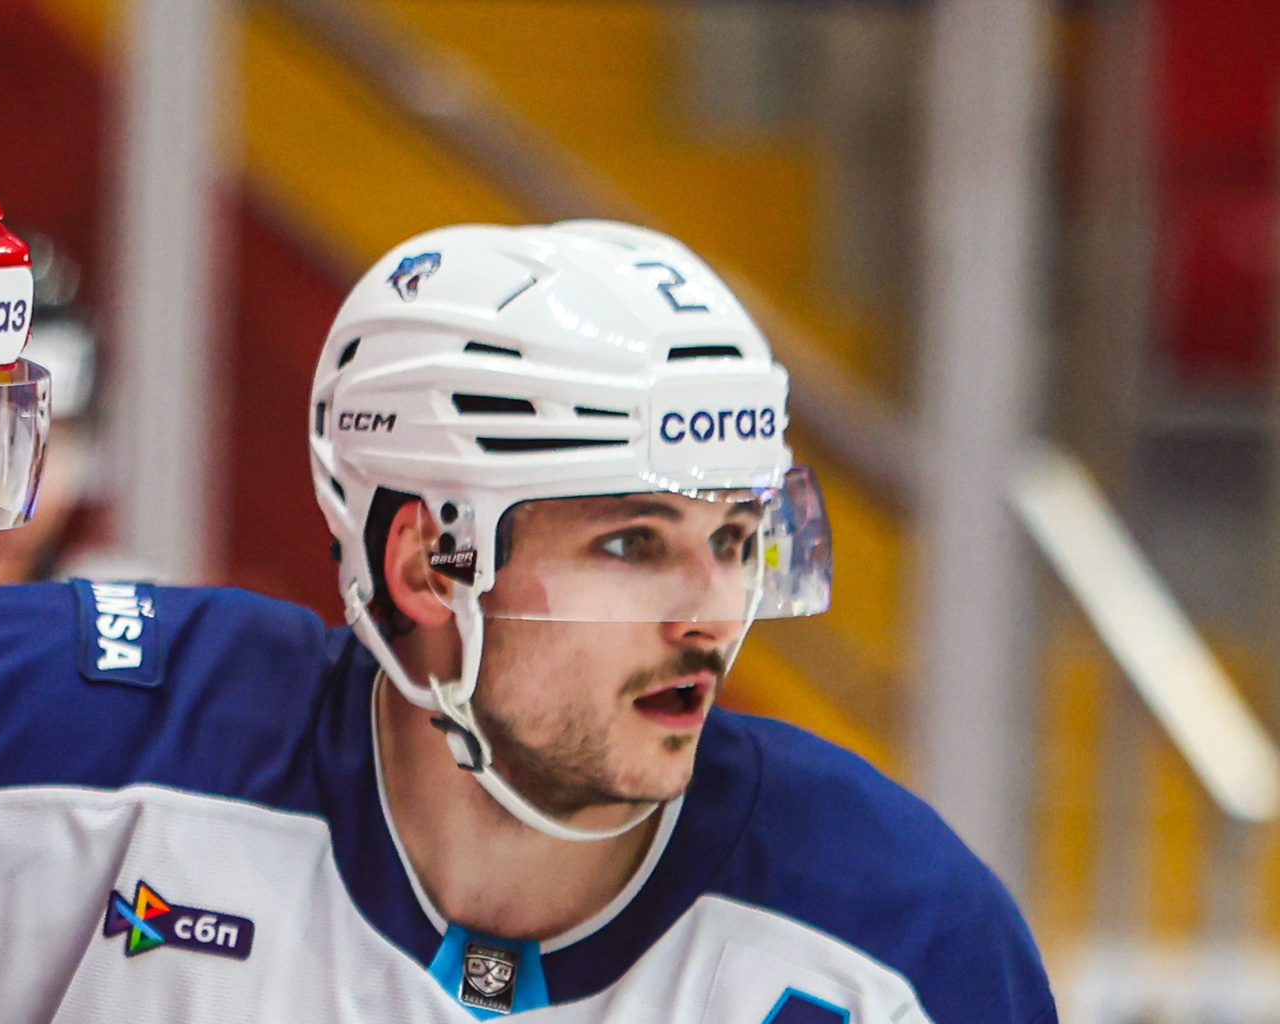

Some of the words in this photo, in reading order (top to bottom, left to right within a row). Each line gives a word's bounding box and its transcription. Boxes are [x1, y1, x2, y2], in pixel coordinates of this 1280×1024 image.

[636, 261, 710, 313] 2
[337, 412, 396, 434] CCM
[660, 407, 776, 444] согаз
[174, 915, 238, 947] сбп
